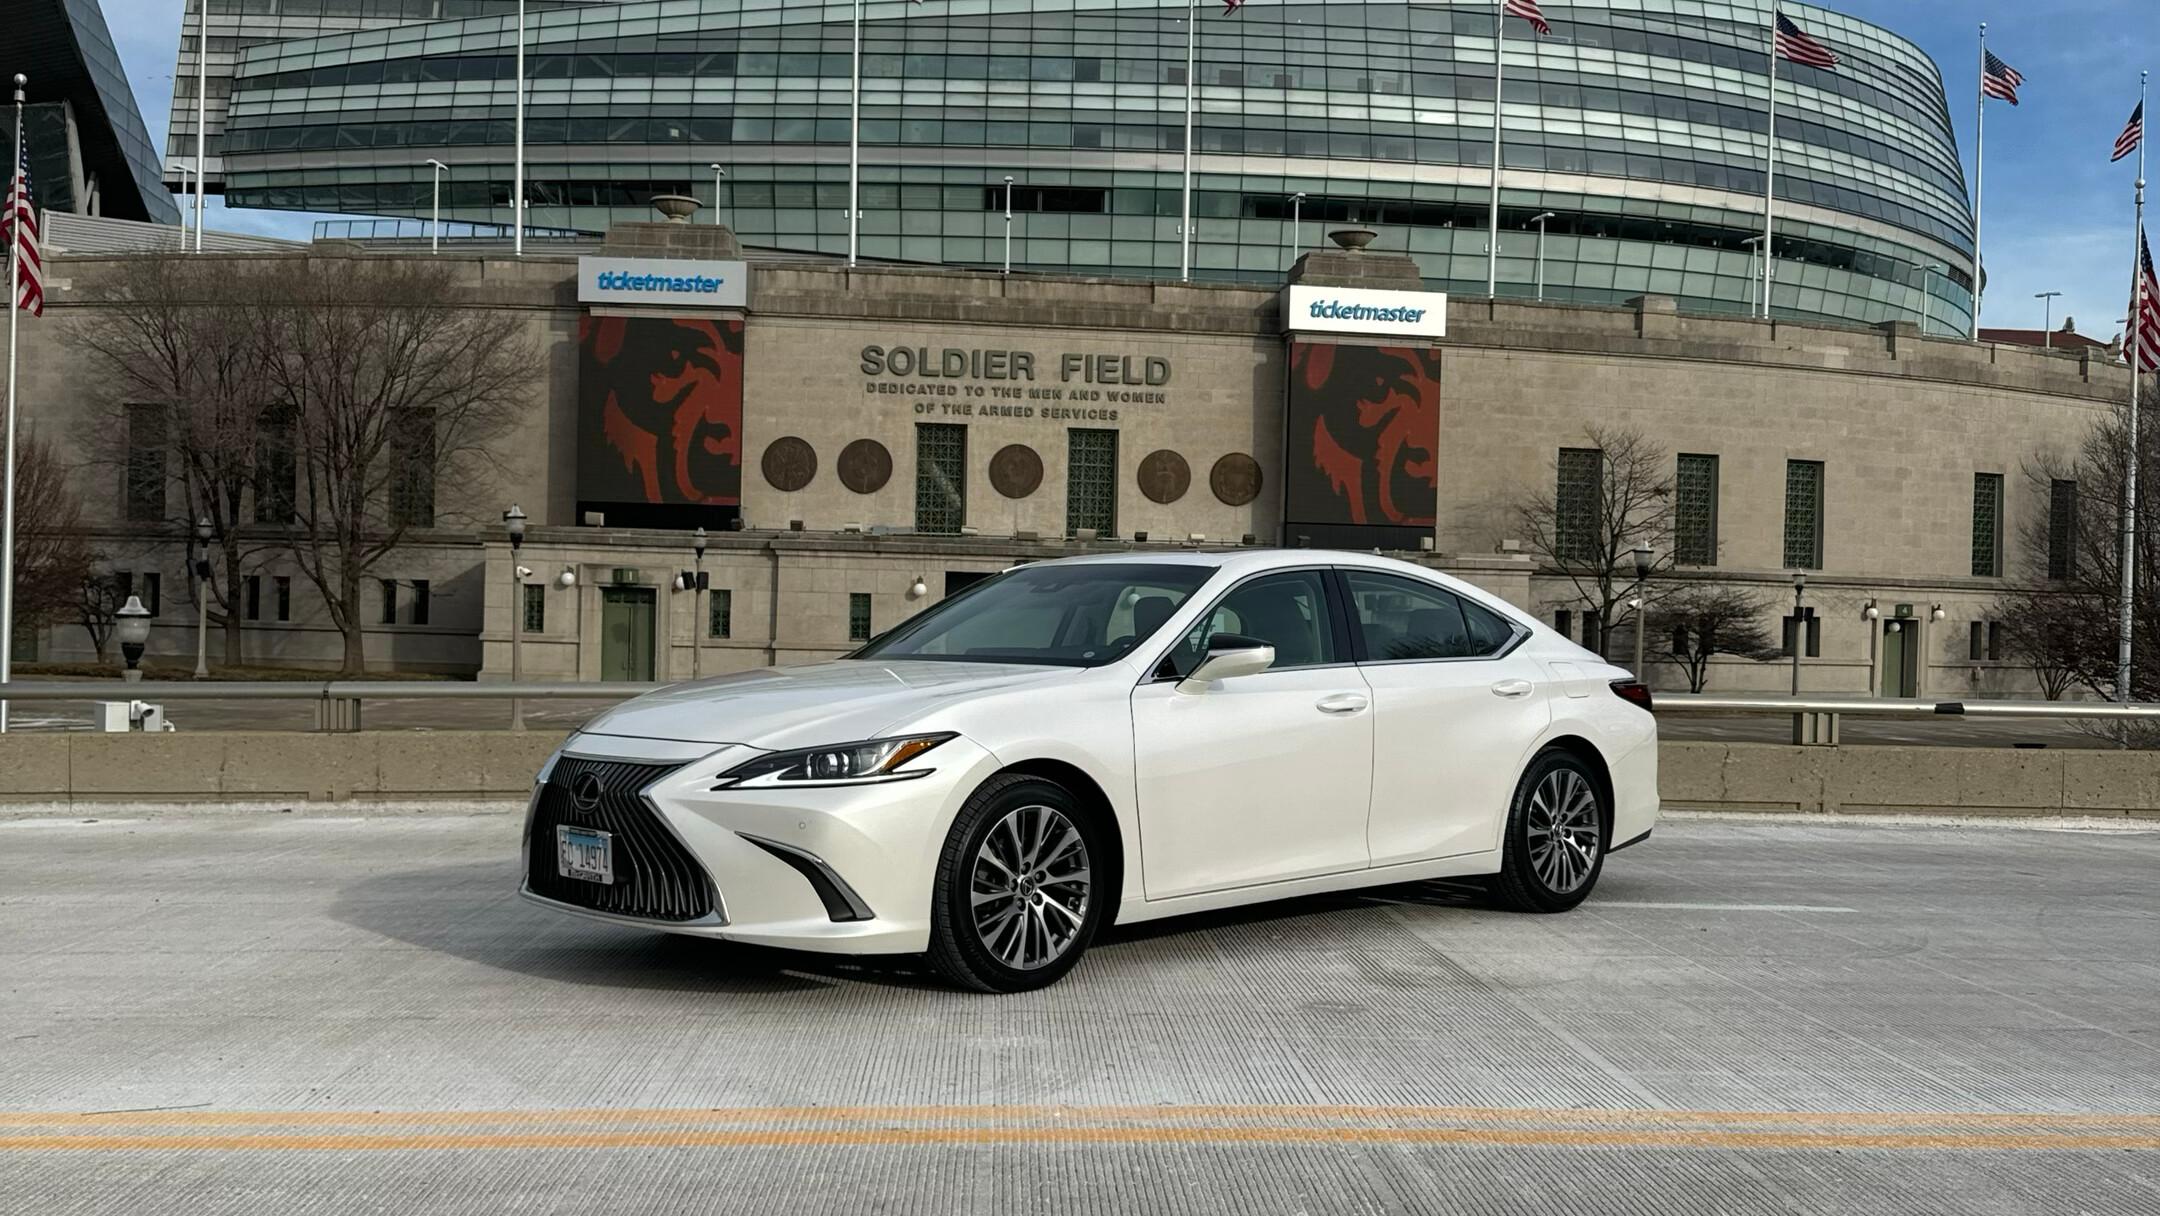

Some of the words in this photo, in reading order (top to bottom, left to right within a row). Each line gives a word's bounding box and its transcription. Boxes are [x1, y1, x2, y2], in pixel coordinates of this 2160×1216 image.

[597, 271, 724, 293] ticketmaster
[1310, 300, 1427, 323] ticketmaster
[860, 344, 1035, 381] SOLDIER
[1060, 352, 1172, 387] FIELD
[866, 382, 957, 397] DEDICATED
[964, 385, 986, 397] TO
[991, 386, 1023, 399] THE
[1028, 388, 1063, 401] MEN
[1068, 390, 1100, 402] AND
[1105, 391, 1166, 405] WOMEN
[914, 402, 935, 415] OF
[941, 403, 973, 416] THE
[978, 405, 1034, 419] ARMED
[1040, 407, 1119, 421] SERVICES
[579, 843, 608, 872] 14974
